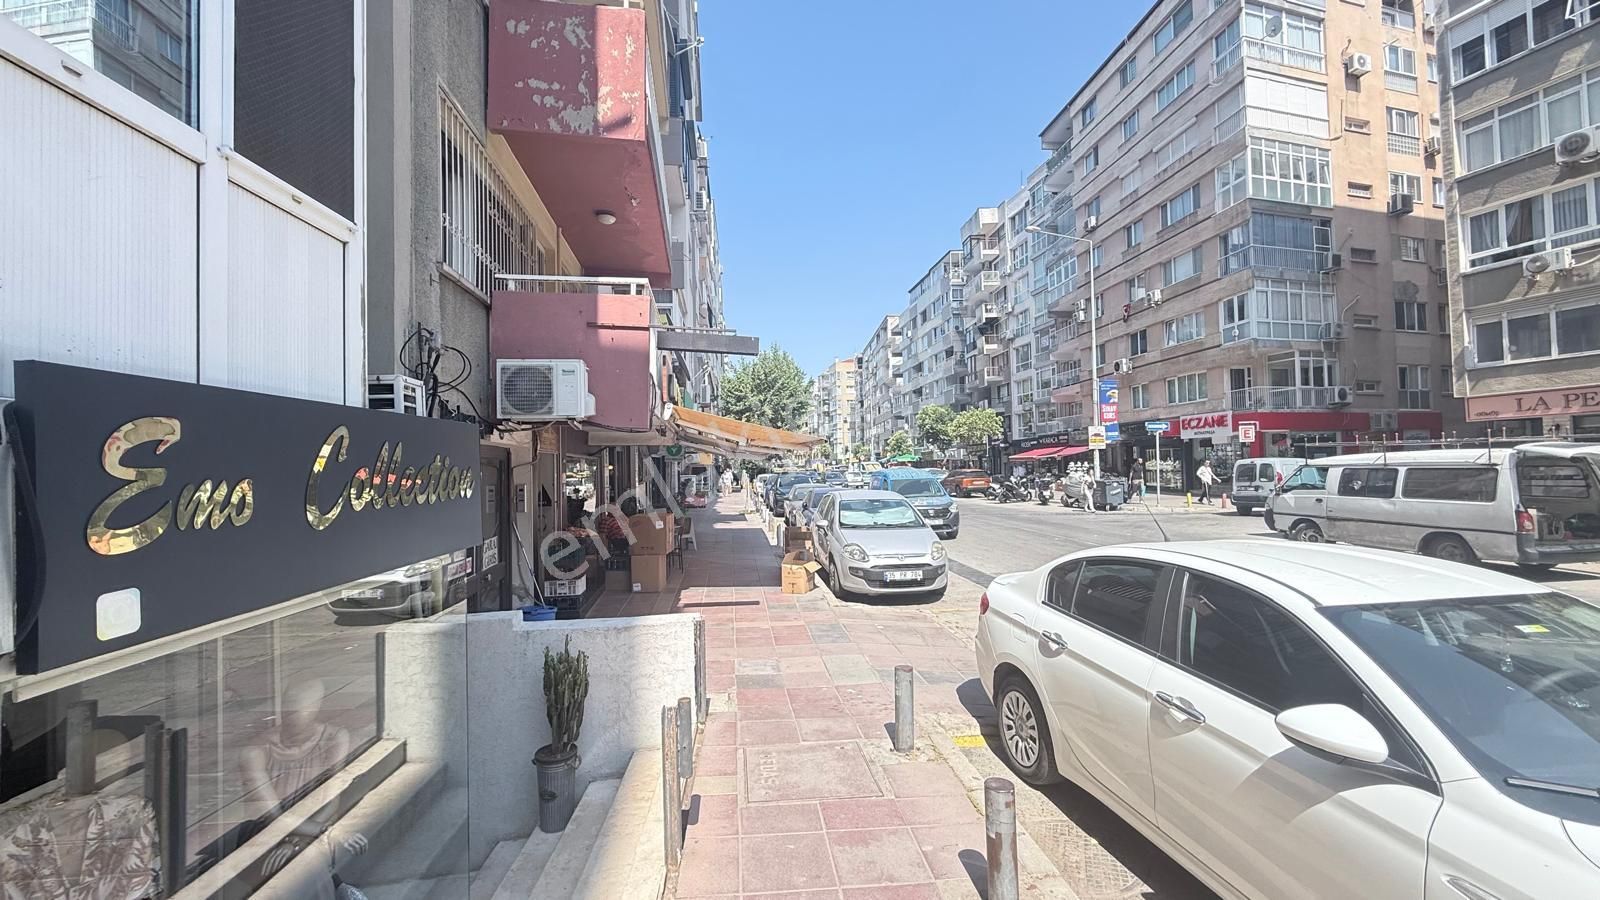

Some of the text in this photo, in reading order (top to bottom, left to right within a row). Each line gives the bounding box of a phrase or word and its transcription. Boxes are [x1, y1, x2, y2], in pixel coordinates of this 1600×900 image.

[1514, 396, 1552, 412] LA
[1181, 413, 1229, 430] ECZANE
[1243, 429, 1252, 439] E
[86, 416, 475, 556] Emo Collection
